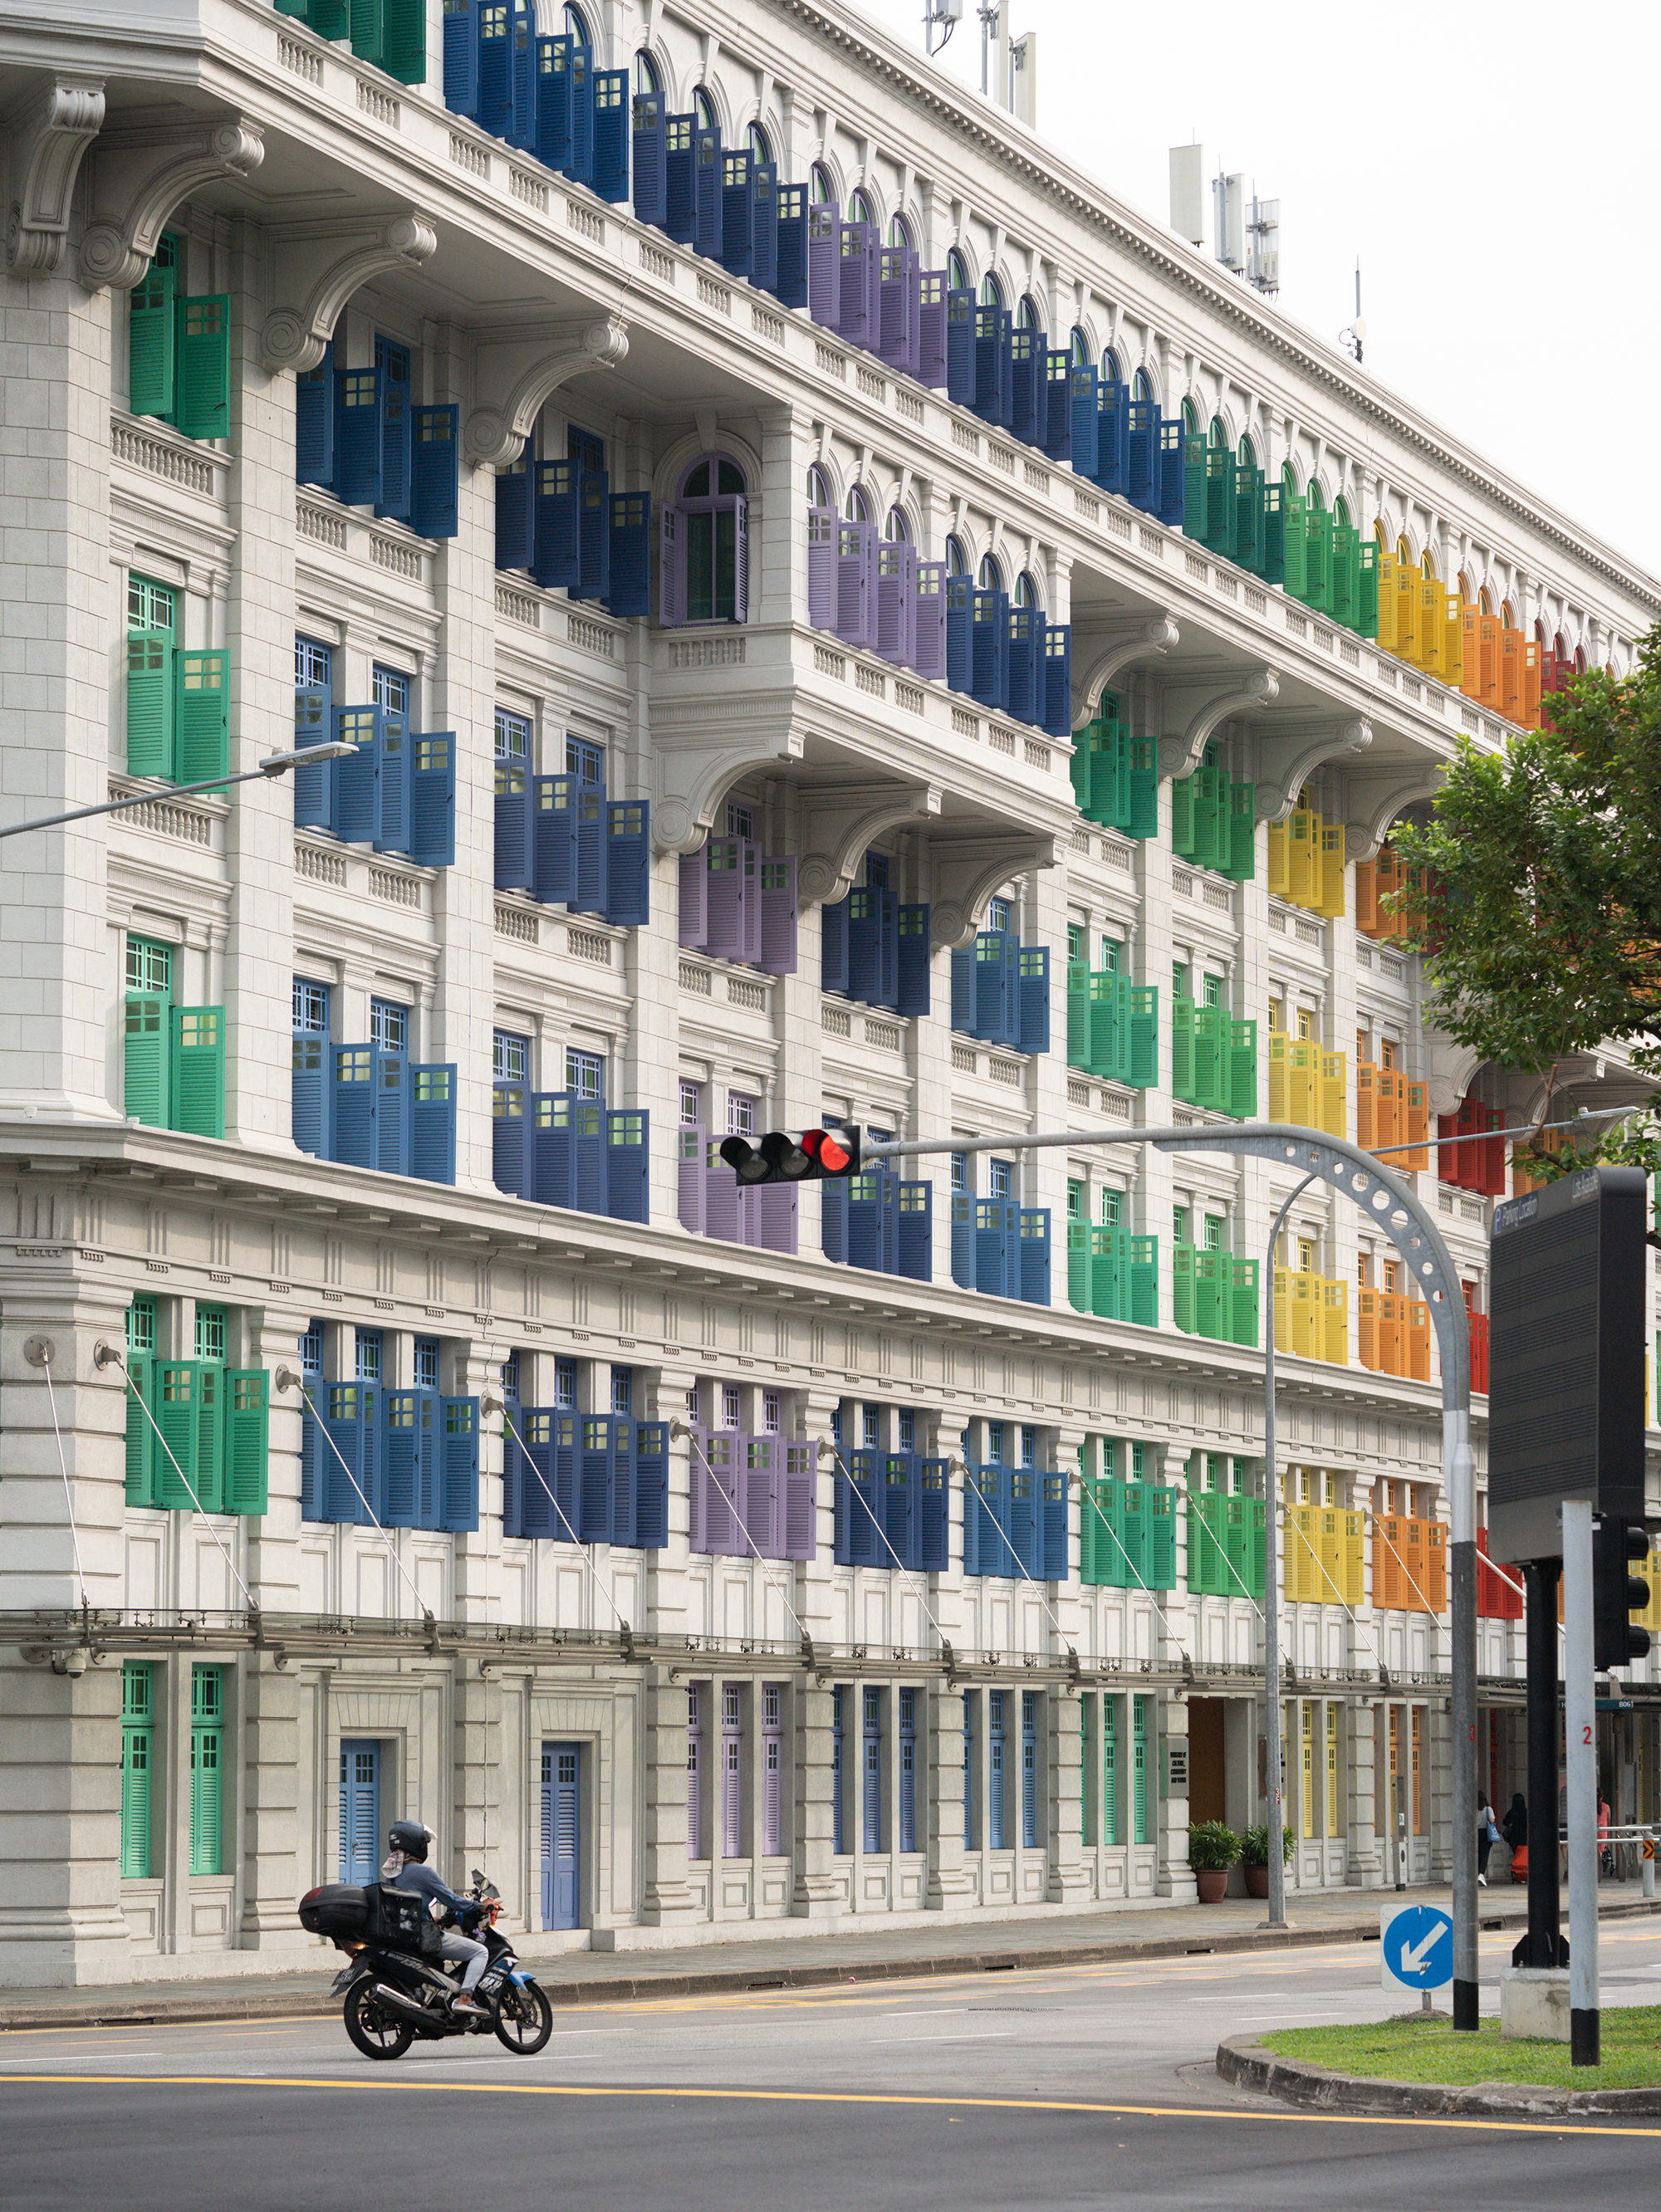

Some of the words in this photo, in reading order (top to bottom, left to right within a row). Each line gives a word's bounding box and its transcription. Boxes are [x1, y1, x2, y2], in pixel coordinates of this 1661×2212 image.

[1502, 1202, 1519, 1227] Parking
[1519, 1194, 1537, 1220] Location
[1469, 1725, 1476, 1741] 3
[1583, 1726, 1592, 1745] 2
